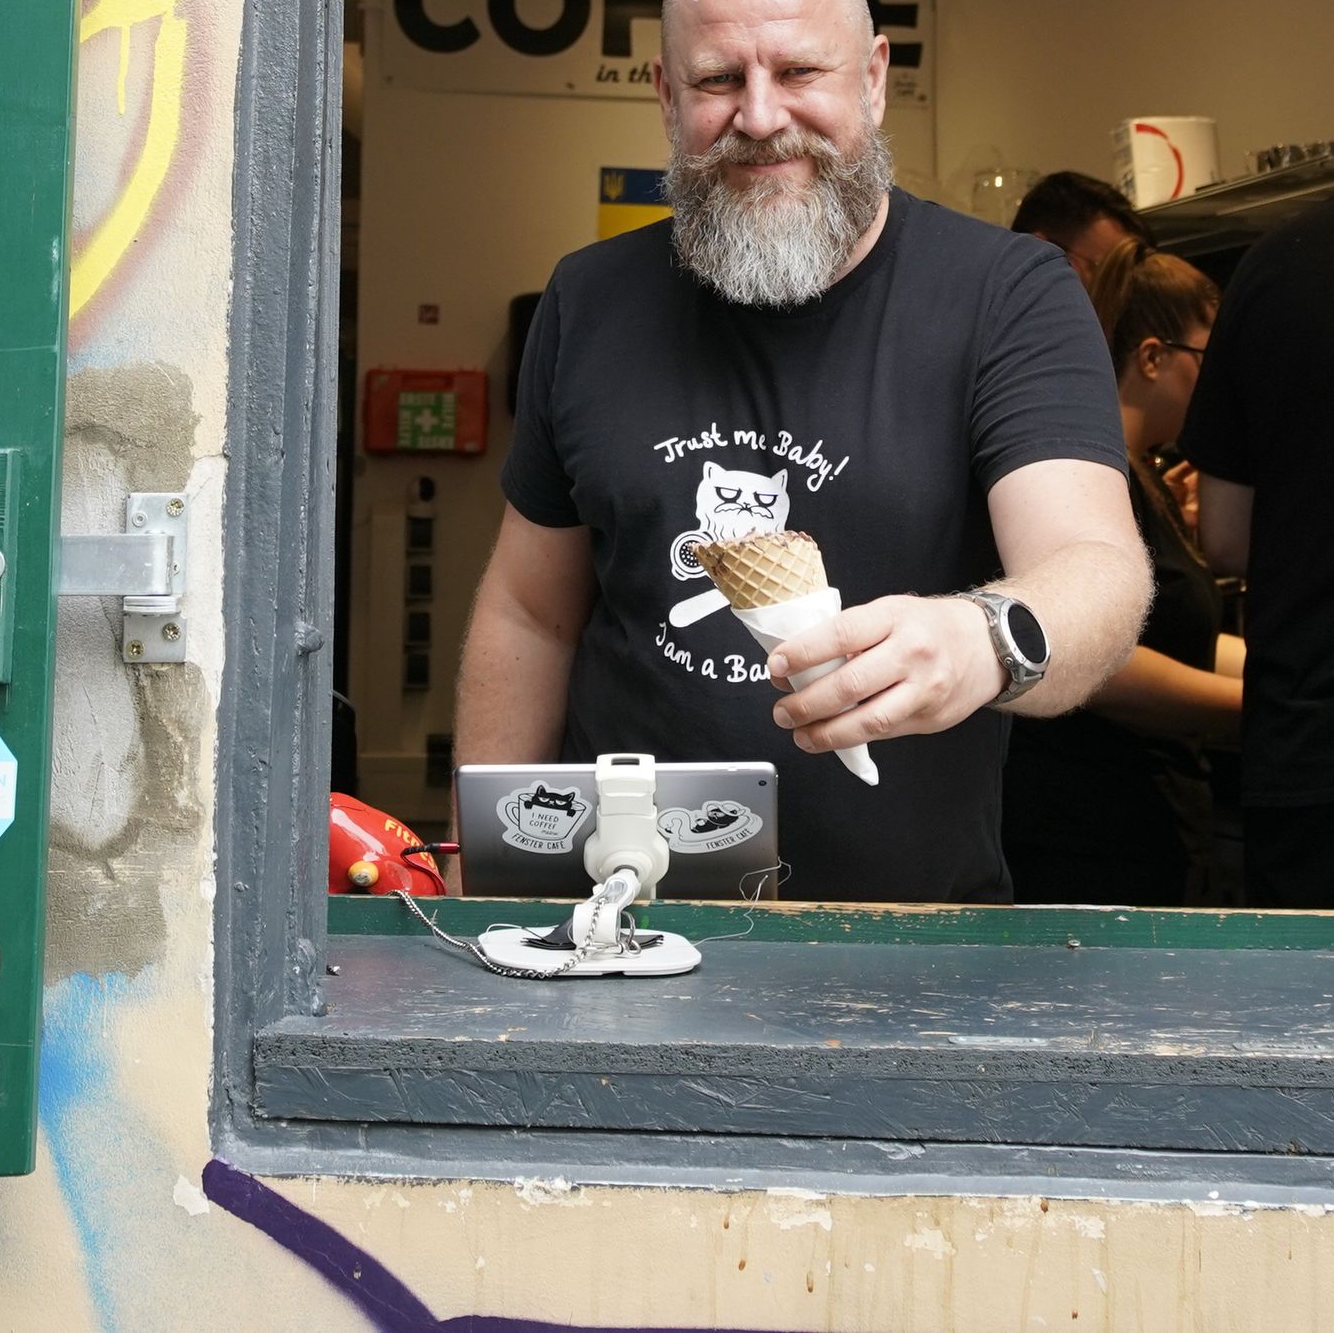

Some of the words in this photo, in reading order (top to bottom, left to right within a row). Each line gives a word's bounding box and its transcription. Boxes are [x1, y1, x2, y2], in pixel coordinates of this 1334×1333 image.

[653, 421, 729, 463] Trust
[733, 429, 767, 451] me
[772, 429, 850, 493] Baby!
[663, 641, 695, 672] am
[701, 657, 719, 680] a
[538, 813, 560, 823] NEED
[512, 833, 544, 850] FENSTER
[706, 836, 735, 850] FENSTER
